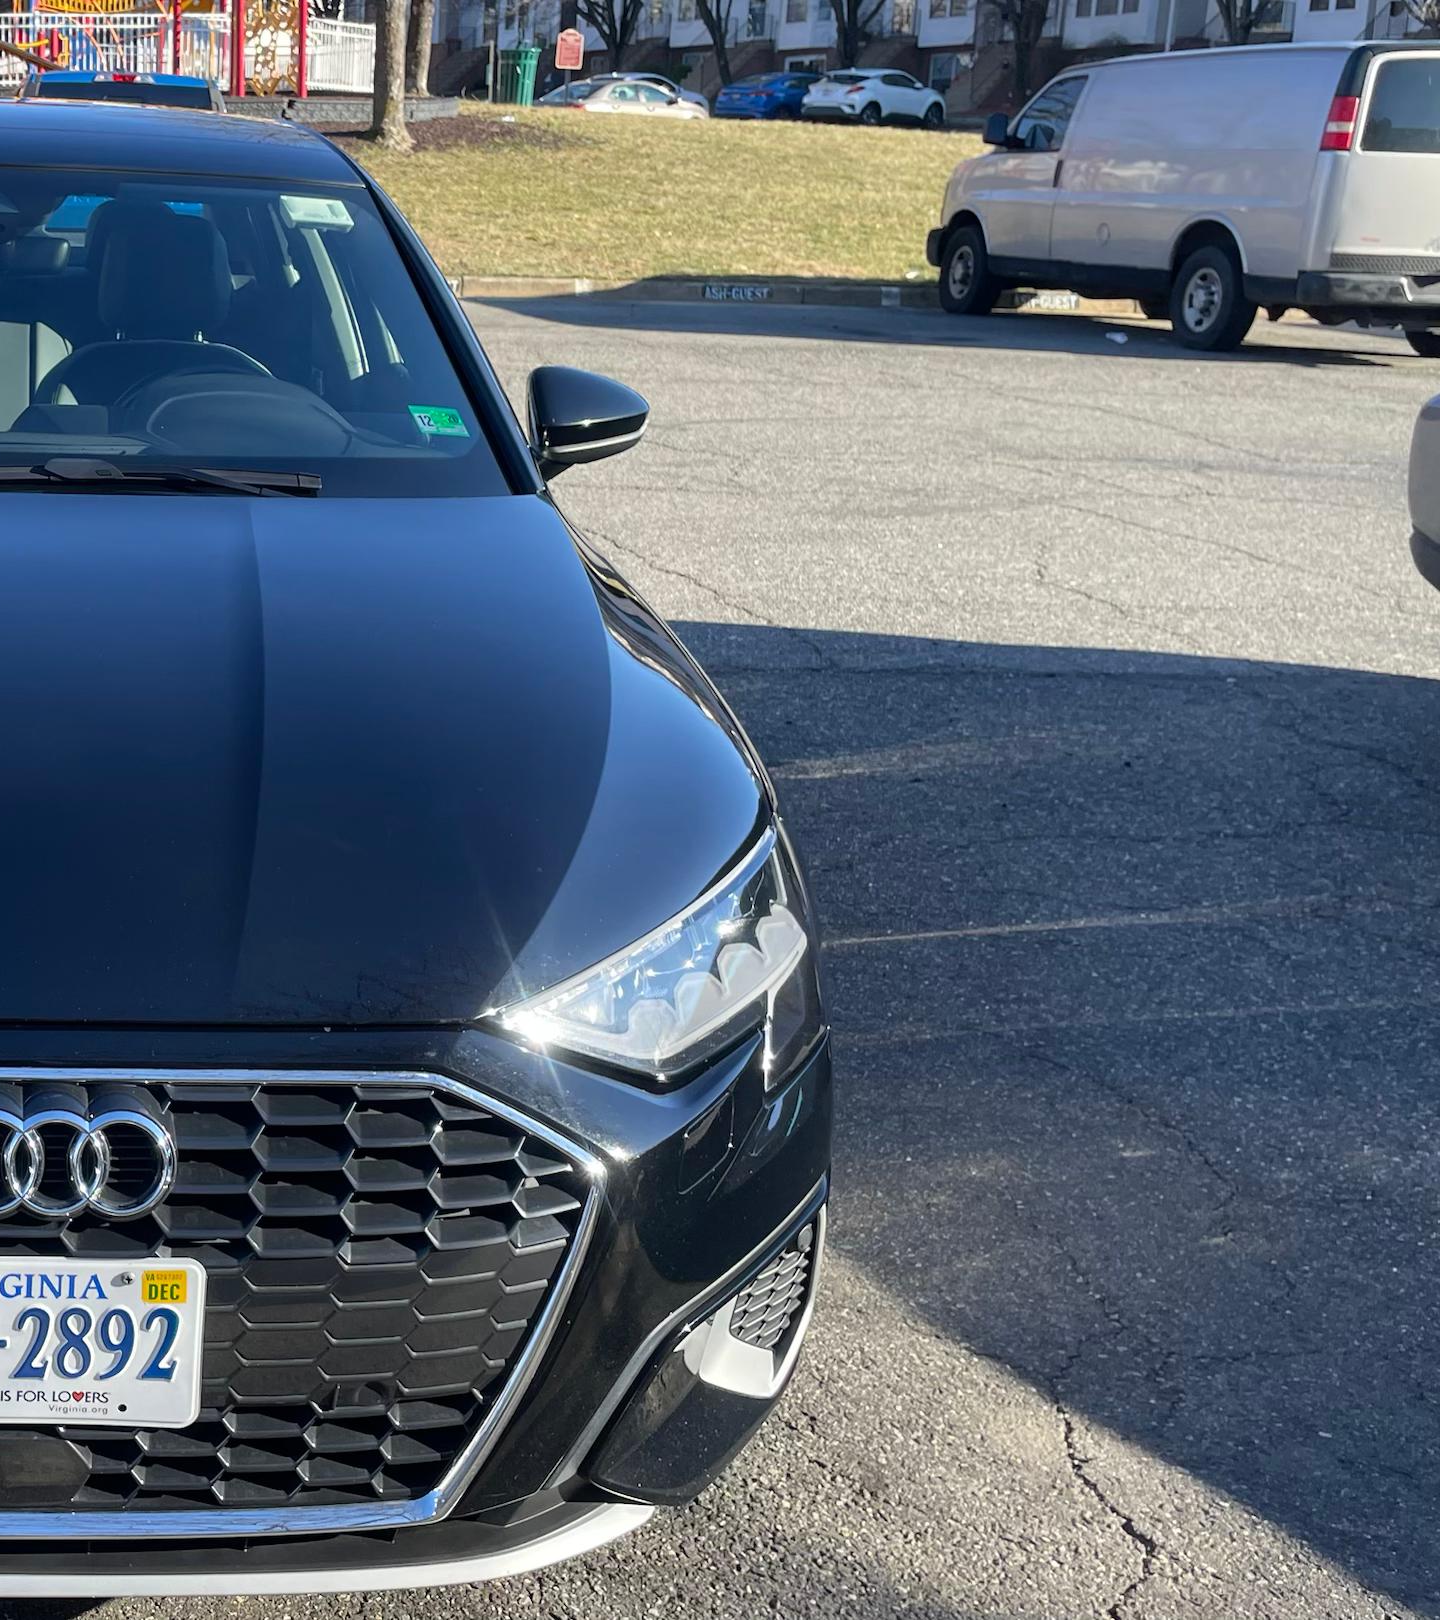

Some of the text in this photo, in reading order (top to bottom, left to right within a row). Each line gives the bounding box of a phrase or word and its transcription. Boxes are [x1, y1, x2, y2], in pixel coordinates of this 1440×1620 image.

[703, 286, 769, 301] ASH-GUEST
[417, 414, 435, 428] 12
[148, 1284, 180, 1300] DEC
[0, 1390, 11, 1402] IS
[16, 1390, 48, 1403] FOR
[48, 1404, 109, 1415] Virginia.org
